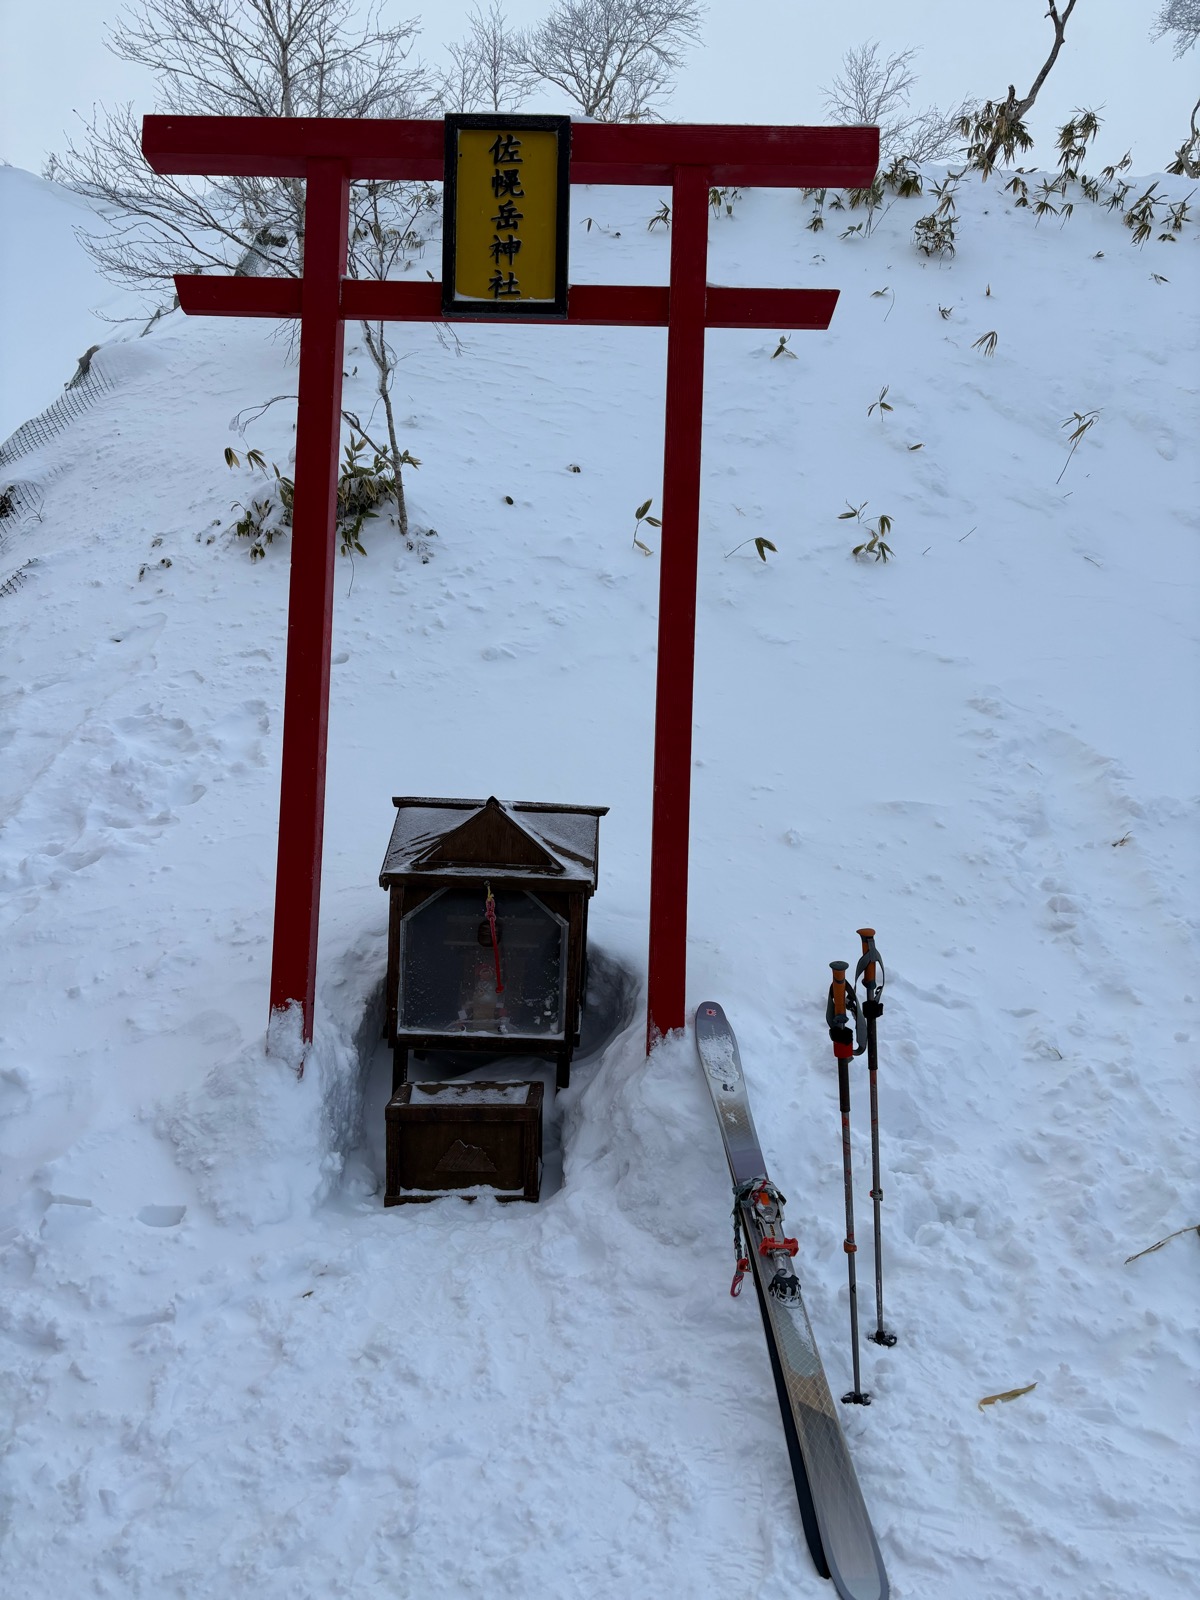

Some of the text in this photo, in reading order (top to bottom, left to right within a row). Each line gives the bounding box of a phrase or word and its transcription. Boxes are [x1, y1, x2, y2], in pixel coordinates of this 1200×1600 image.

[488, 134, 524, 298] 佐幌岳神社
